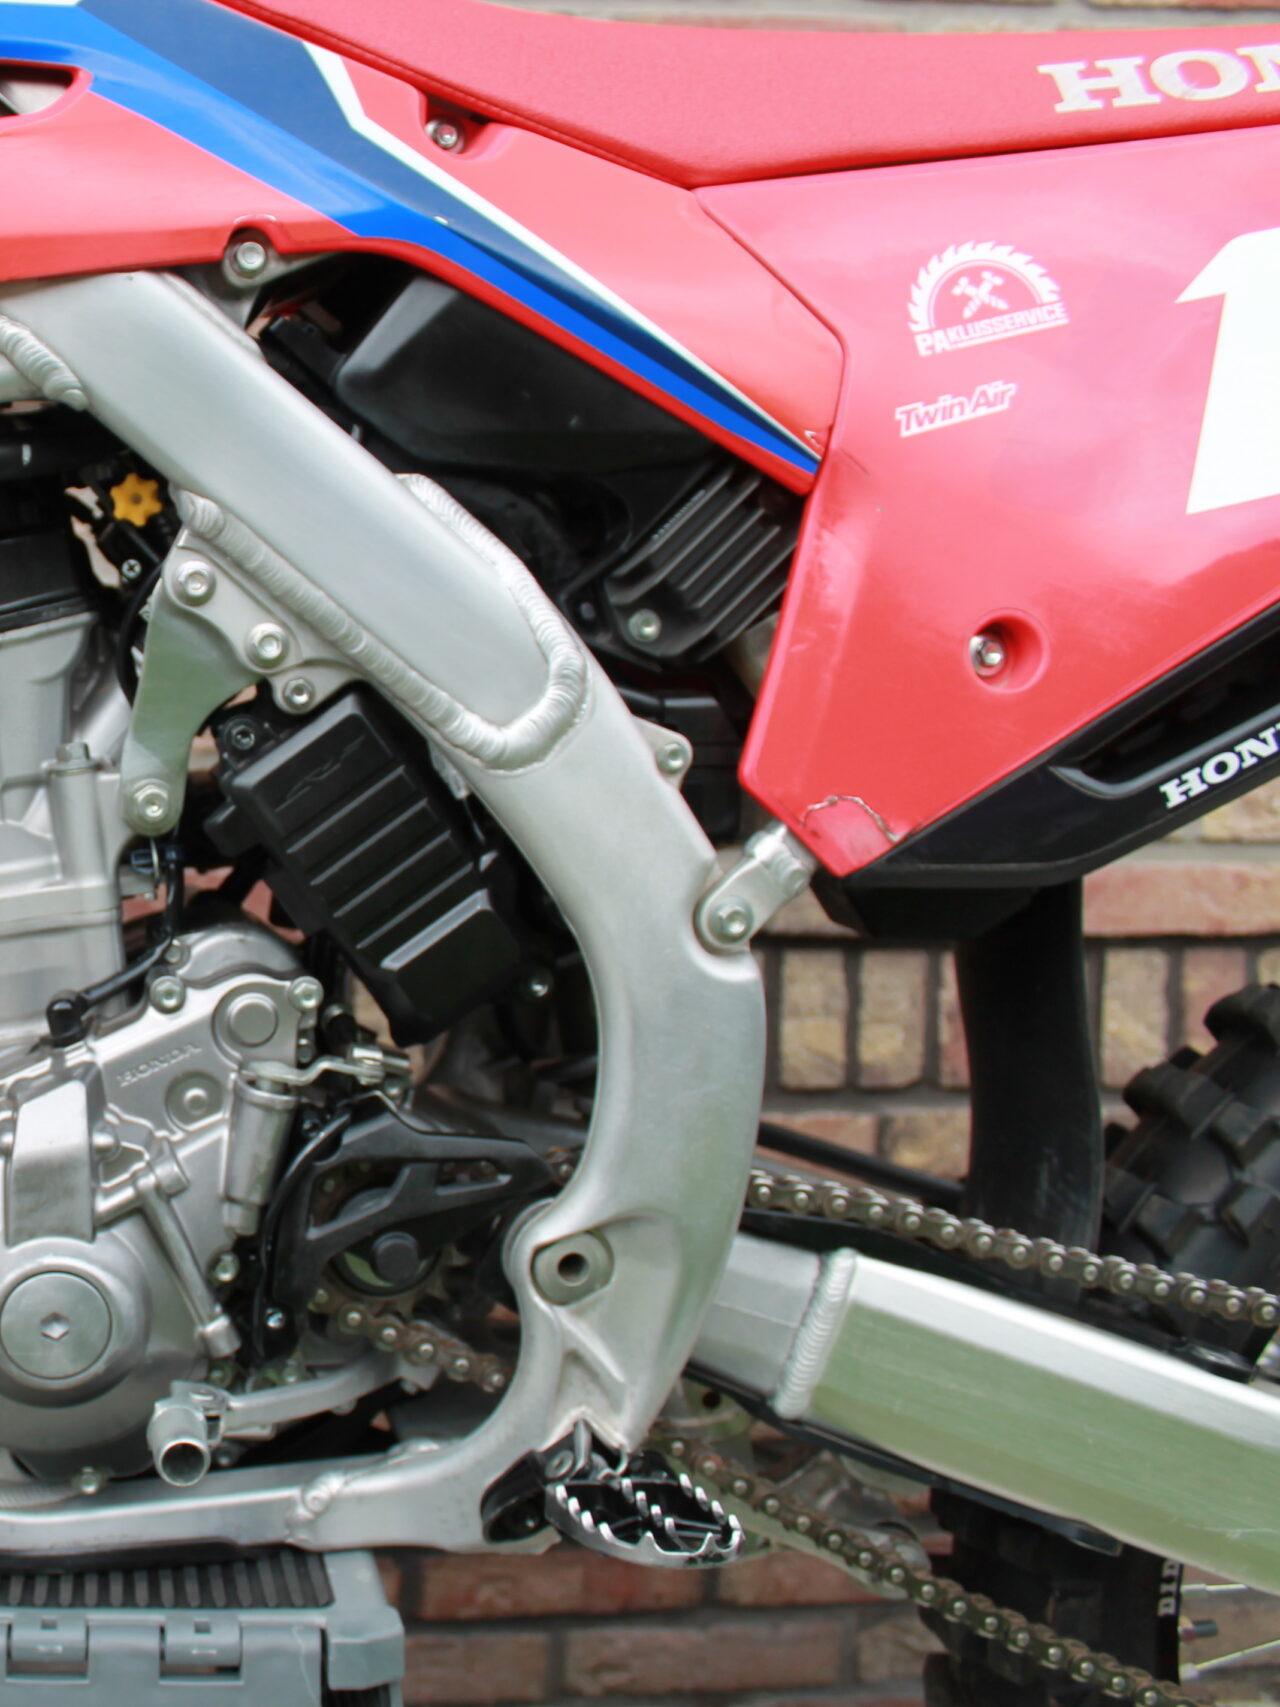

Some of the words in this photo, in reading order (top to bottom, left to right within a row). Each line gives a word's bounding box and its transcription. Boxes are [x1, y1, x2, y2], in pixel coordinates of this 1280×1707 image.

[895, 395, 969, 437] Twin
[970, 381, 1017, 416] Air
[1159, 722, 1280, 809] HON
